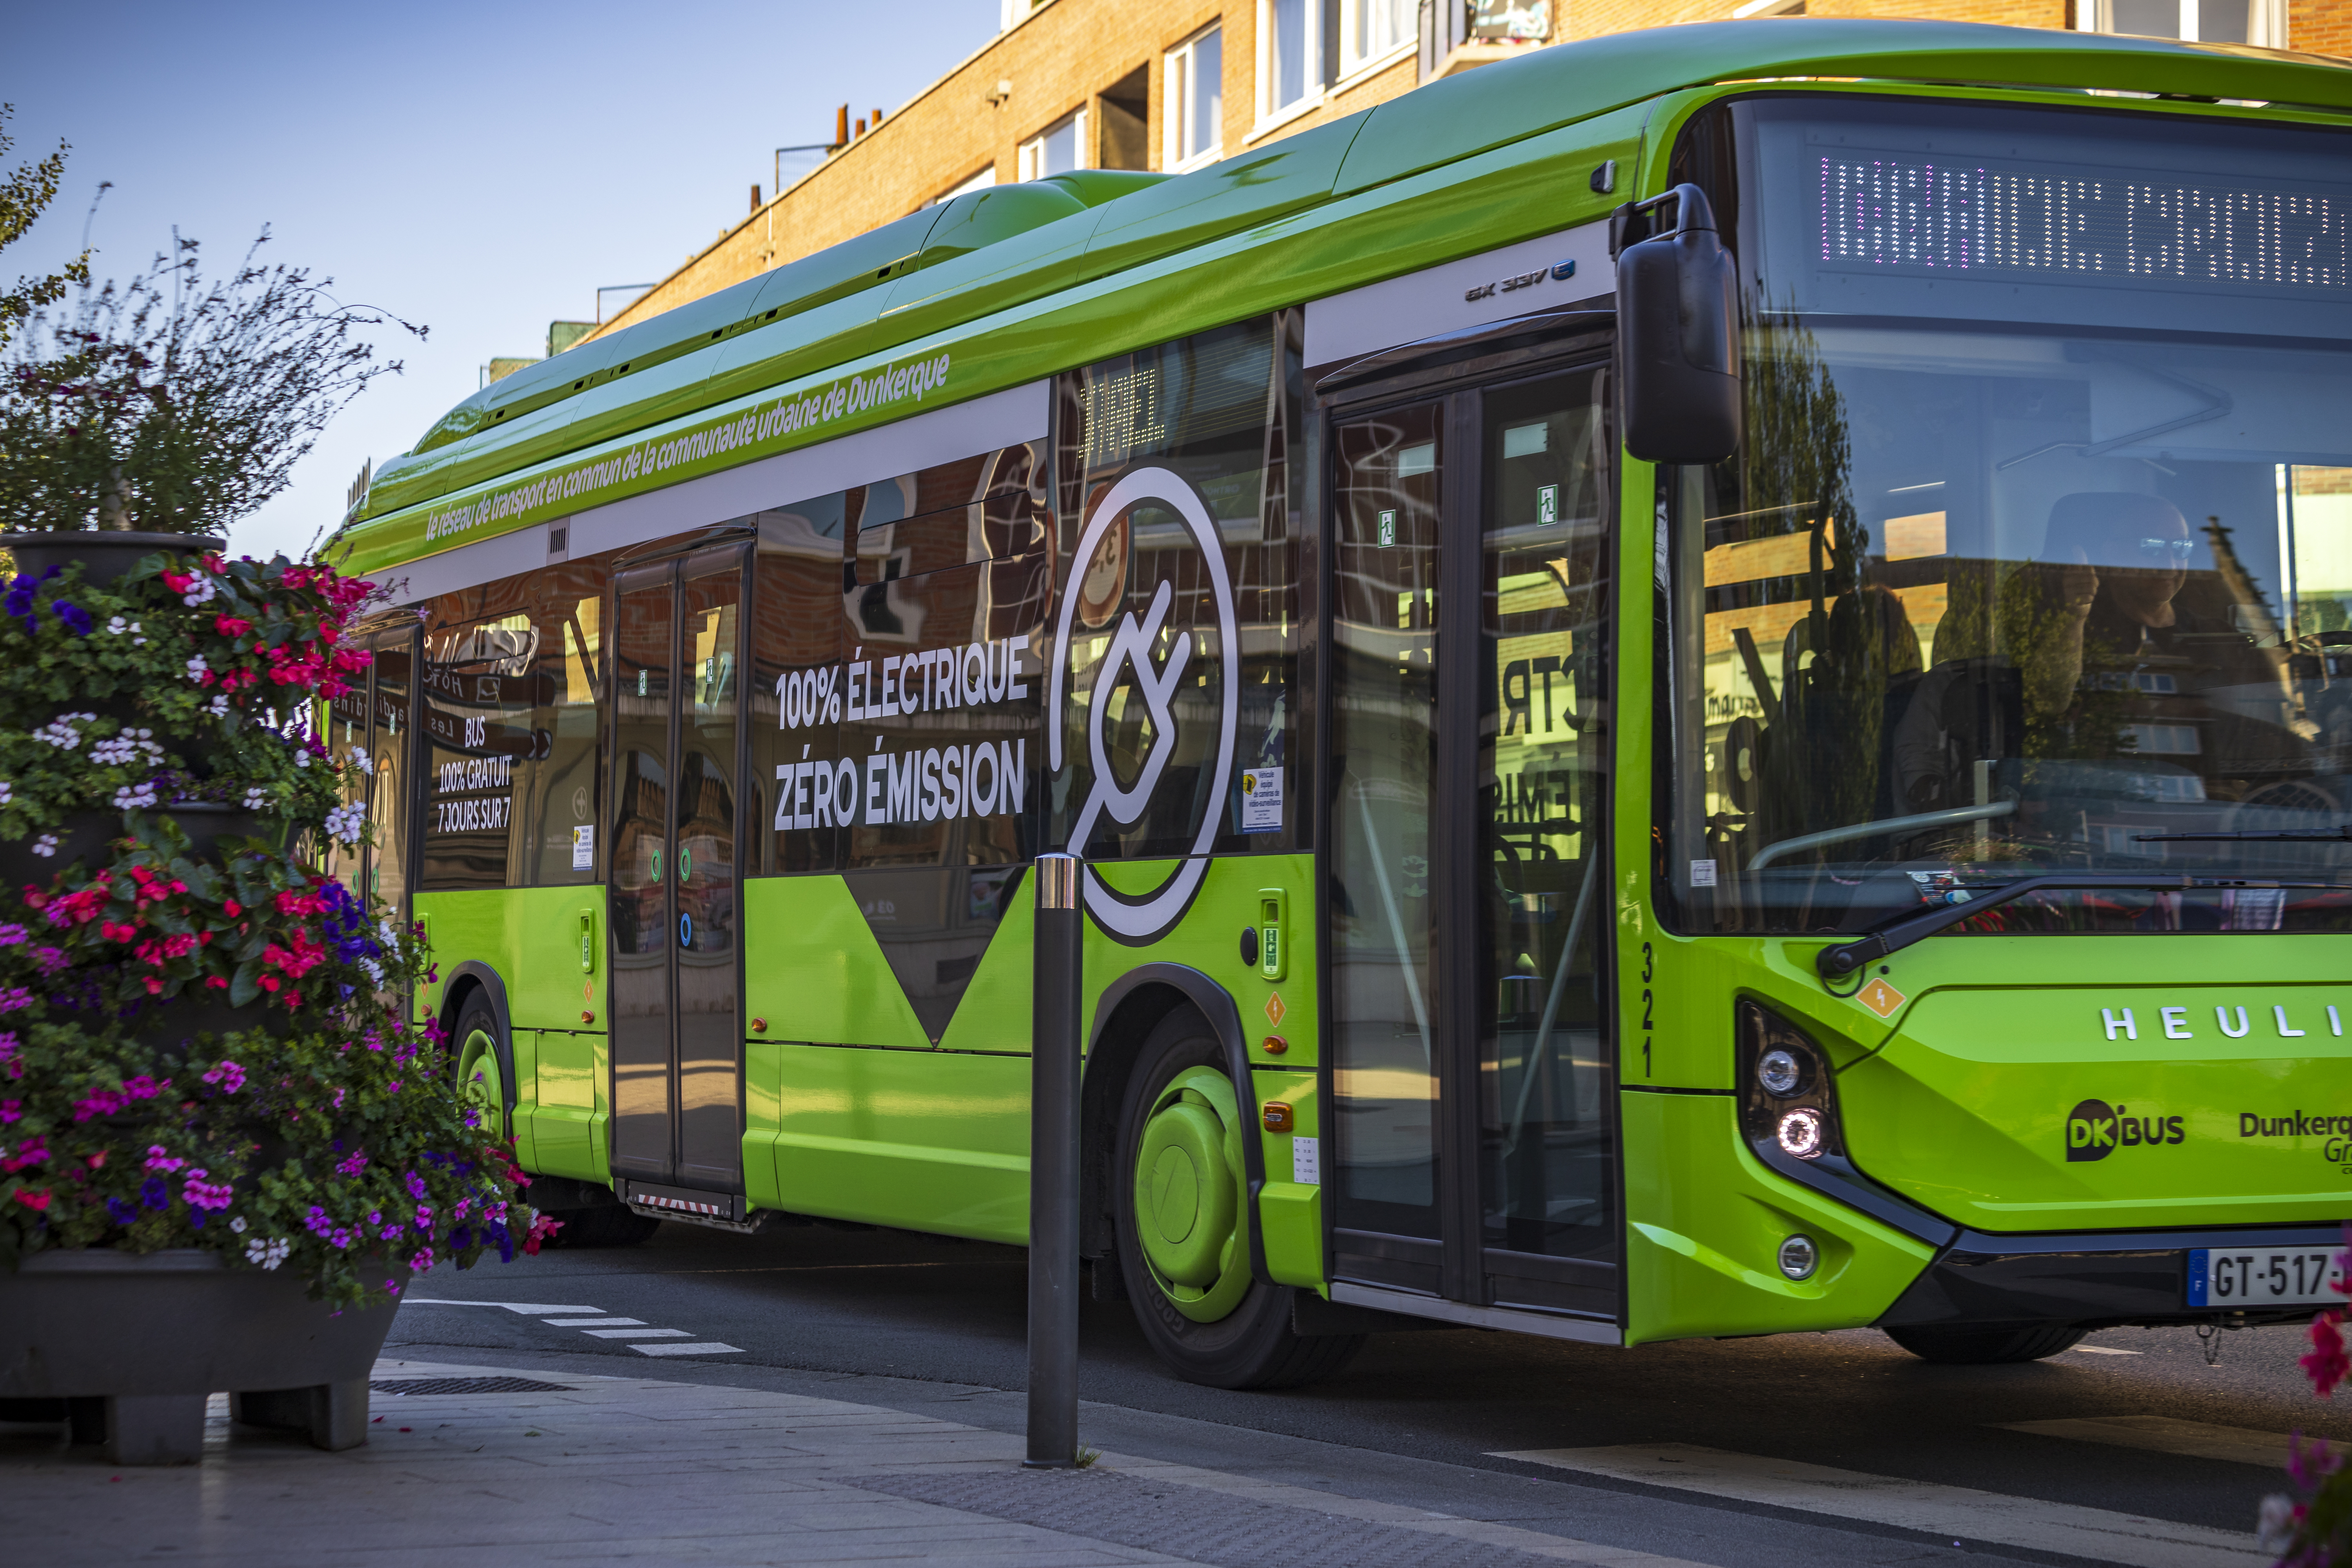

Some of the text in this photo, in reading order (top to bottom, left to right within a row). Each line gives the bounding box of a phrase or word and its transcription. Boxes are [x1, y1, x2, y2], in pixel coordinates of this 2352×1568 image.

[1465, 282, 1495, 301] GX
[1501, 268, 1548, 292] 337
[426, 353, 949, 541] le réseau de transport en commun de la communauté urbaine de Dunkerque
[776, 635, 1029, 730] 100% ÉLECTRIQUE
[465, 715, 485, 748] BUS
[439, 755, 512, 793] 100% GRATUIT
[775, 735, 1025, 831] ZÉRO ÉMISSION
[438, 797, 510, 833] 7 JOURS SUR 7
[2100, 1005, 2343, 1041] HEULI
[2324, 1137, 2352, 1162] Gr
[2194, 1279, 2203, 1291] F
[2216, 1254, 2346, 1297] GT-517-
